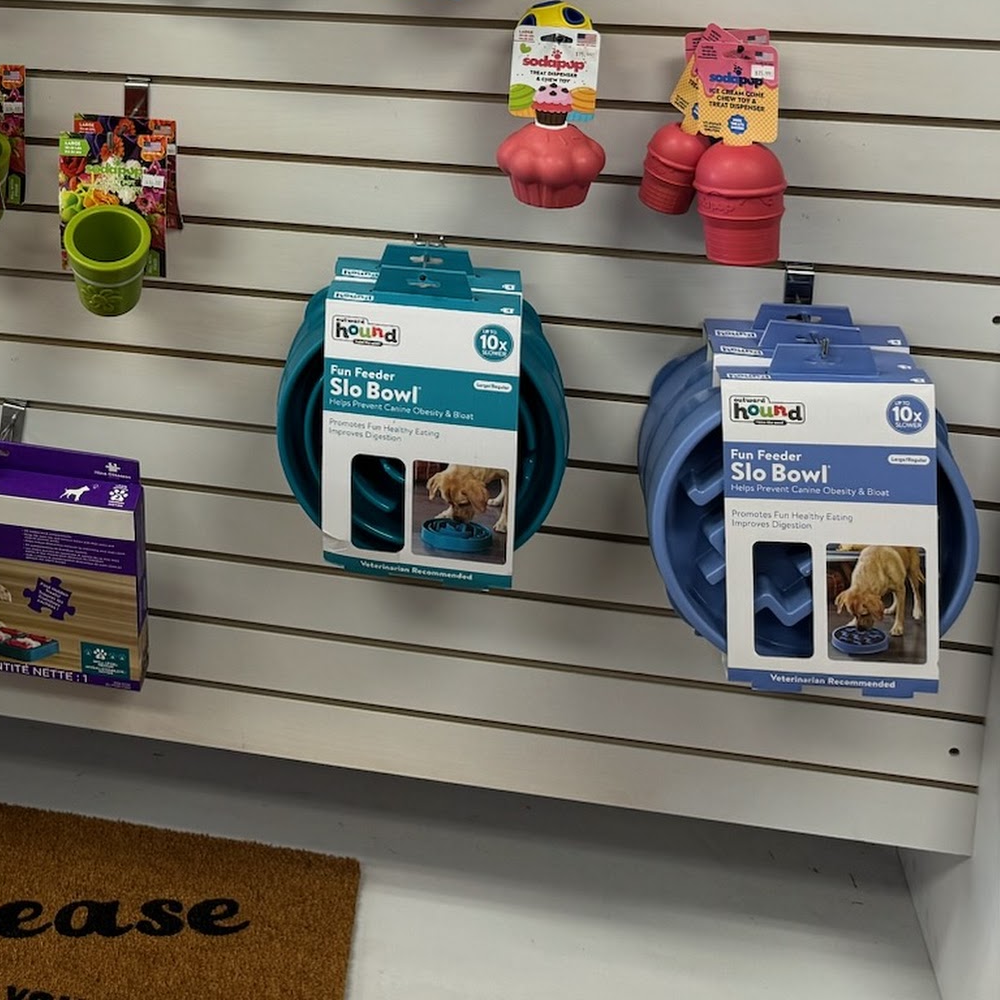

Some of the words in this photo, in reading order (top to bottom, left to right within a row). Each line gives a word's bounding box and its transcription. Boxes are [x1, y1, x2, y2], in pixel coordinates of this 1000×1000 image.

[523, 56, 584, 72] sodapup
[709, 72, 763, 88] sodapup
[730, 103, 765, 112] DISPENSER
[336, 323, 398, 344] hound
[479, 335, 508, 351] 10x
[330, 365, 351, 377] Fun
[355, 367, 395, 381] Feeder
[330, 378, 362, 397] Slo
[367, 381, 418, 404] Bowl
[733, 403, 802, 422] hound
[892, 406, 922, 423] 10x
[731, 448, 754, 461] Fun
[757, 450, 802, 462] Feeder
[731, 464, 766, 482] Slo
[772, 464, 828, 484] Bowl
[731, 484, 755, 493] Helps
[757, 484, 789, 493] Prevent
[792, 485, 821, 495] Canine
[823, 487, 857, 497] Obesity
[858, 488, 865, 496] &
[867, 487, 890, 497] Bloat
[32, 667, 73, 681] NETTE
[83, 674, 88, 682] 1
[770, 674, 825, 685] Veterinarian
[828, 678, 896, 689] Recommended
